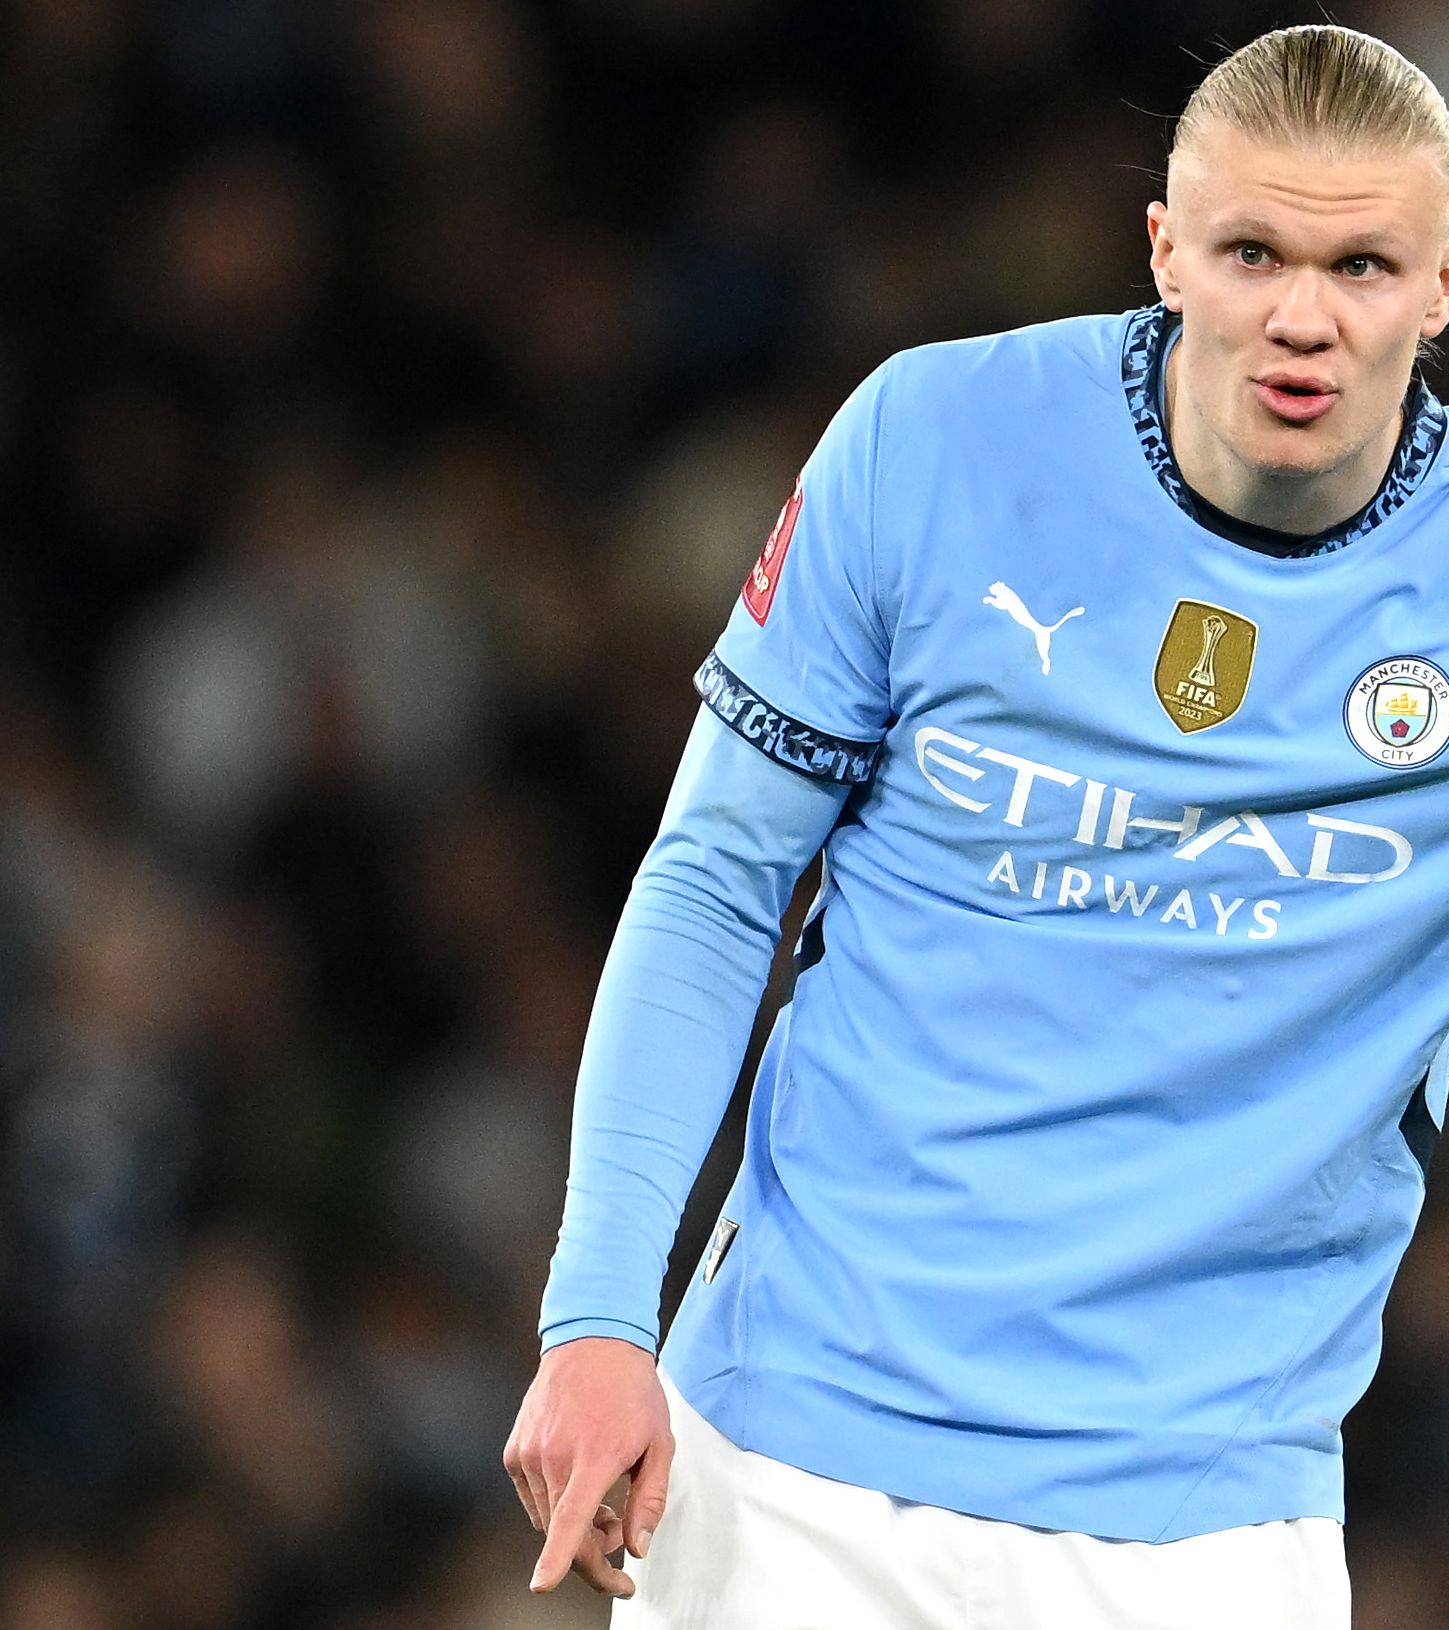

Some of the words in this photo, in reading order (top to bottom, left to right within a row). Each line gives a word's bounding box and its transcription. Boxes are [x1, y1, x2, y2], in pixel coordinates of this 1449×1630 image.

[1176, 681, 1215, 707] FIFA
[1359, 663, 1448, 700] MANCHESTER
[1178, 706, 1203, 721] 2023
[1381, 749, 1414, 761] CITY
[914, 726, 1414, 884] ETIHAD
[986, 850, 1283, 940] AIRWAYS
